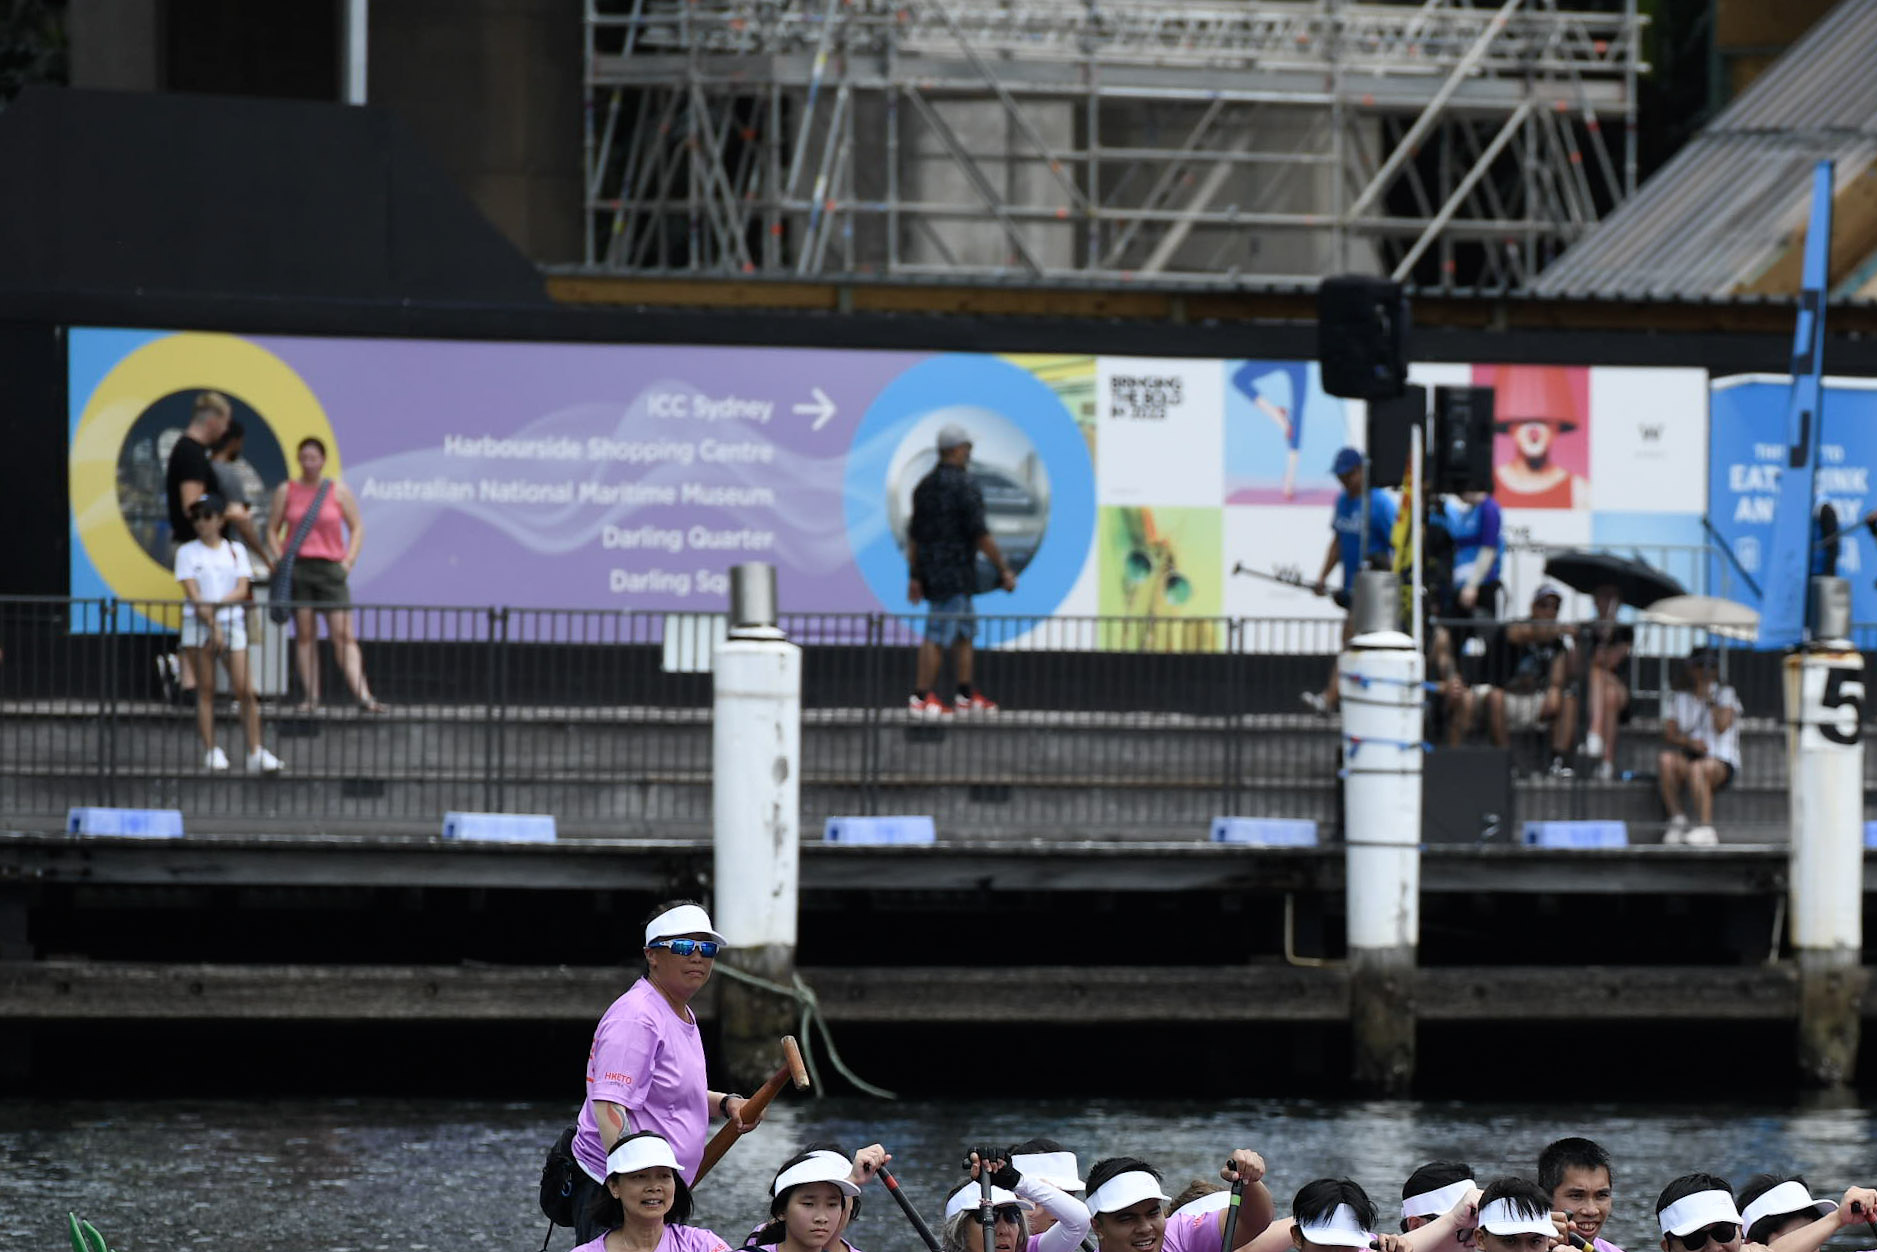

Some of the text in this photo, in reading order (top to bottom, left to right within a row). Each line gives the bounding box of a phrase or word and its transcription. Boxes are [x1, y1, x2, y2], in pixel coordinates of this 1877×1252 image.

[647, 394, 774, 423] ICC Sydney
[444, 433, 774, 466] Harbourside Shopping Centre
[361, 478, 775, 506] Australian National Maritime Museum
[1734, 497, 1776, 523] AN
[603, 525, 775, 553] Darling Quarter
[610, 568, 691, 597] Darling
[1818, 668, 1865, 745] 5
[605, 1072, 632, 1085] HKETO
